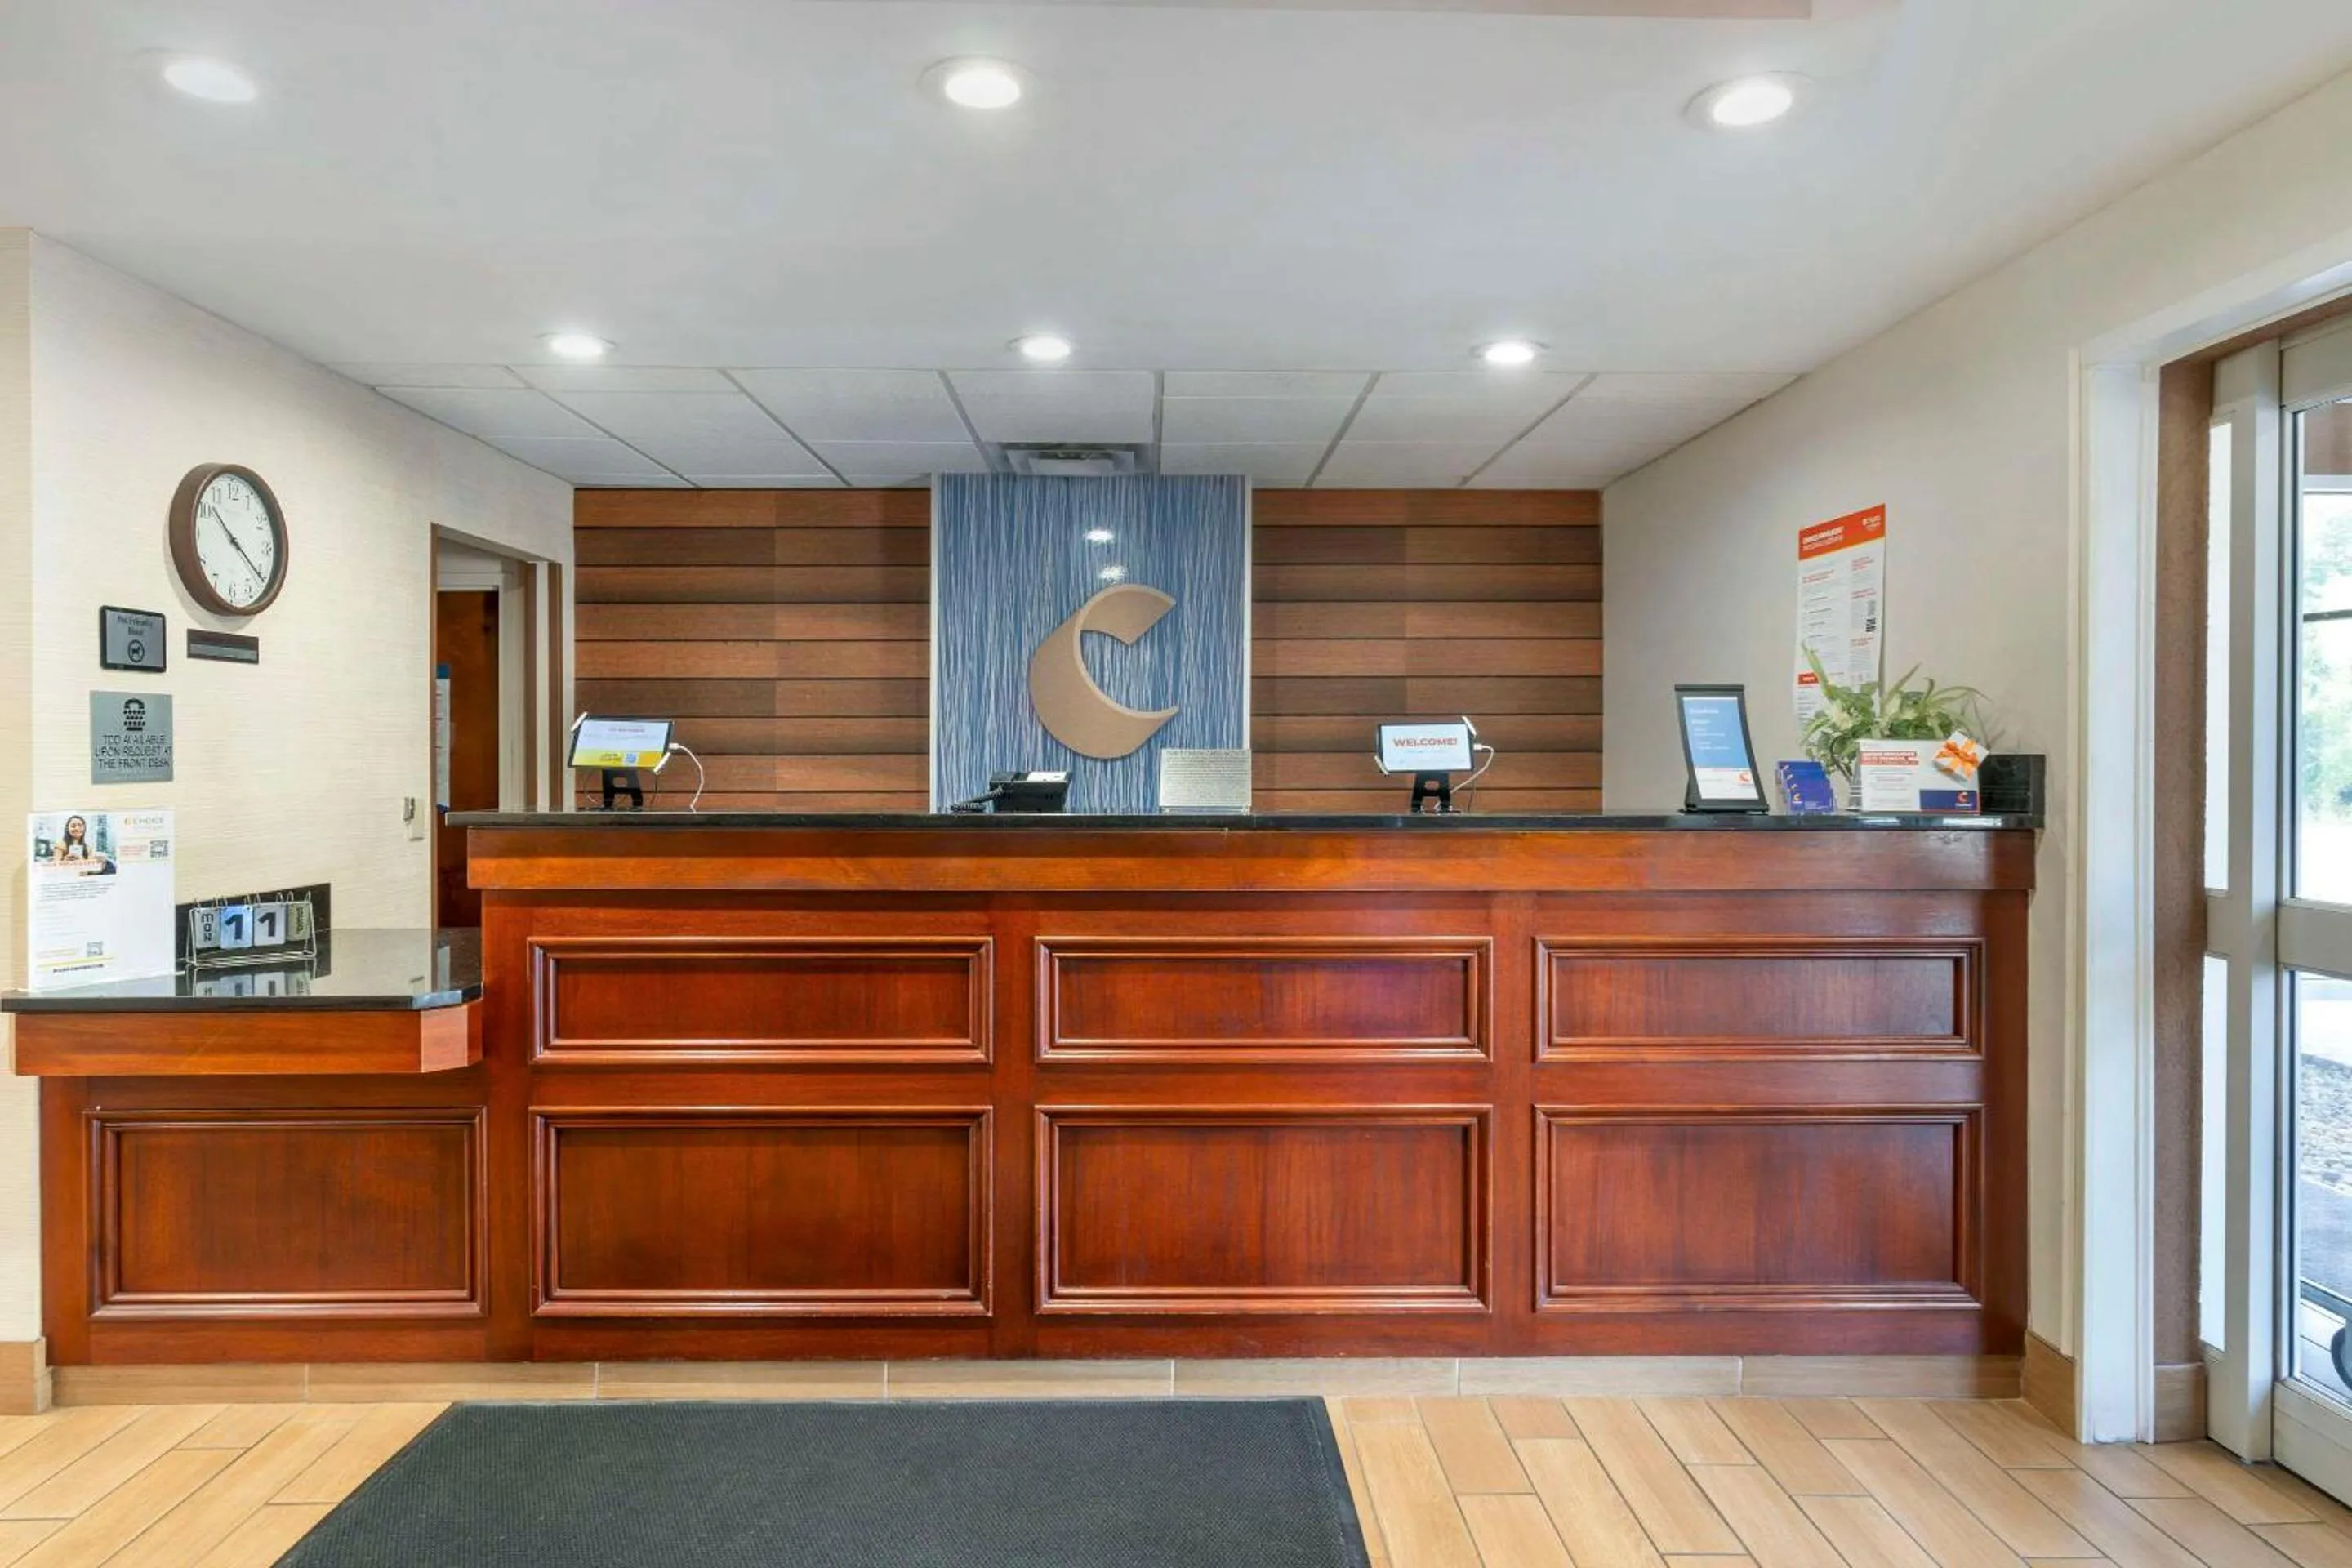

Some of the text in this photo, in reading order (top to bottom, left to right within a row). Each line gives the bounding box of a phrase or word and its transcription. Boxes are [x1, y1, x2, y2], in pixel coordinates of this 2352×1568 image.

[212, 487, 222, 504] 11
[227, 483, 239, 501] 12
[199, 501, 211, 519] 10
[228, 581, 237, 598] 6
[102, 734, 166, 745] TDD AVAILABLE
[1392, 737, 1458, 747] WELCOME!
[95, 746, 121, 757] UPON
[123, 746, 161, 756] REQUEST
[98, 757, 170, 768] THE FRONT DESK
